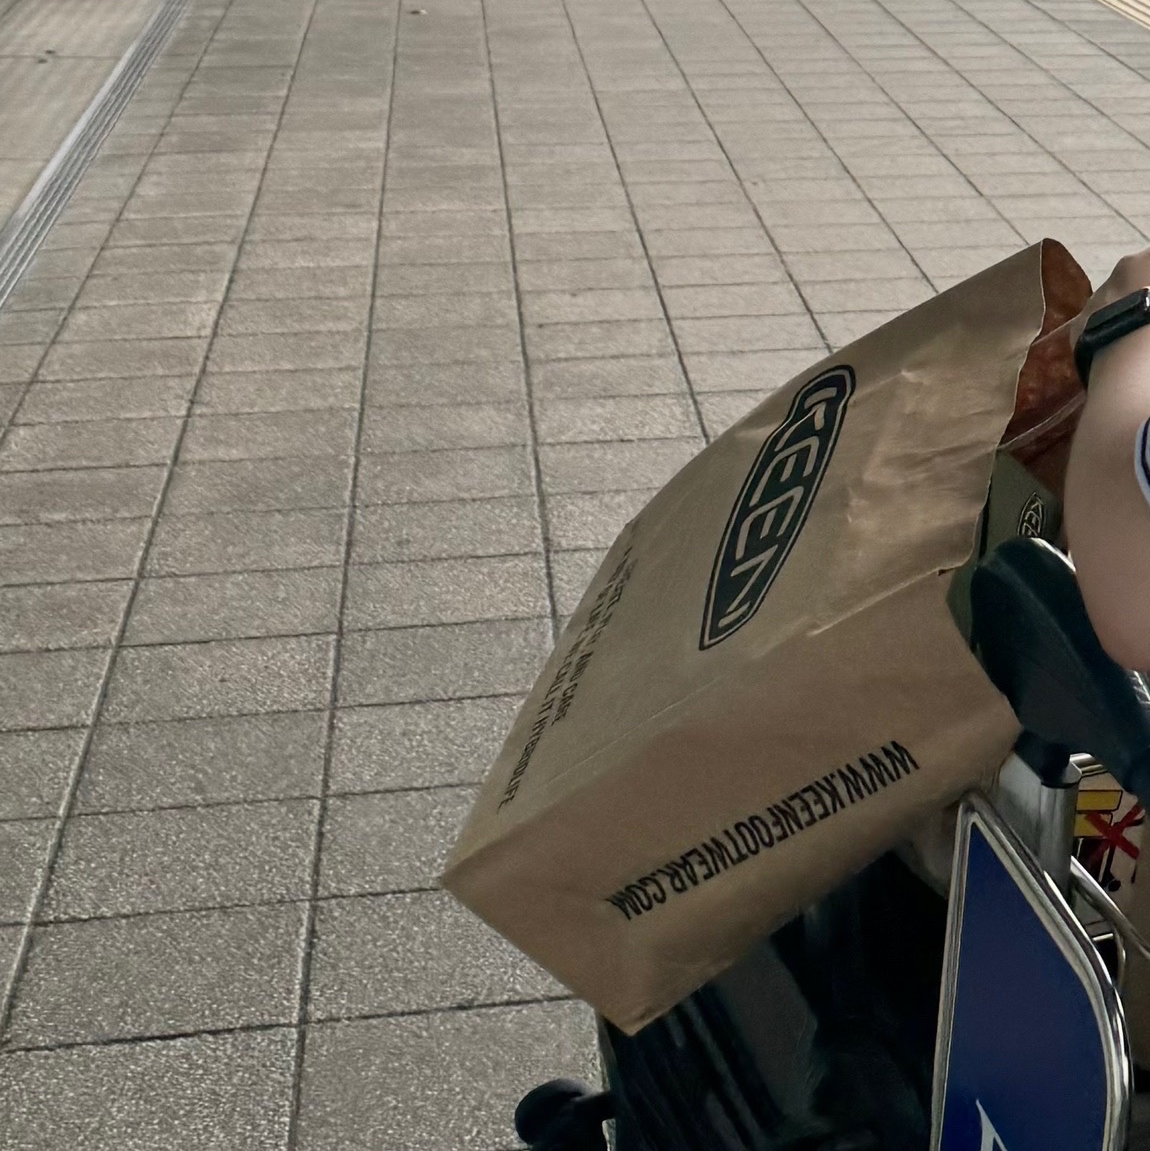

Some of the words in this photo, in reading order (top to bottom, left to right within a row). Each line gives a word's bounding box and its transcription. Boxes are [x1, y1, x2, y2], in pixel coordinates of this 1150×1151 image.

[718, 386, 838, 629] KEEN
[1021, 501, 1043, 537] KEE
[538, 697, 556, 715] IT
[604, 740, 920, 921] WWW.KEENFOOTWEAR.COM
